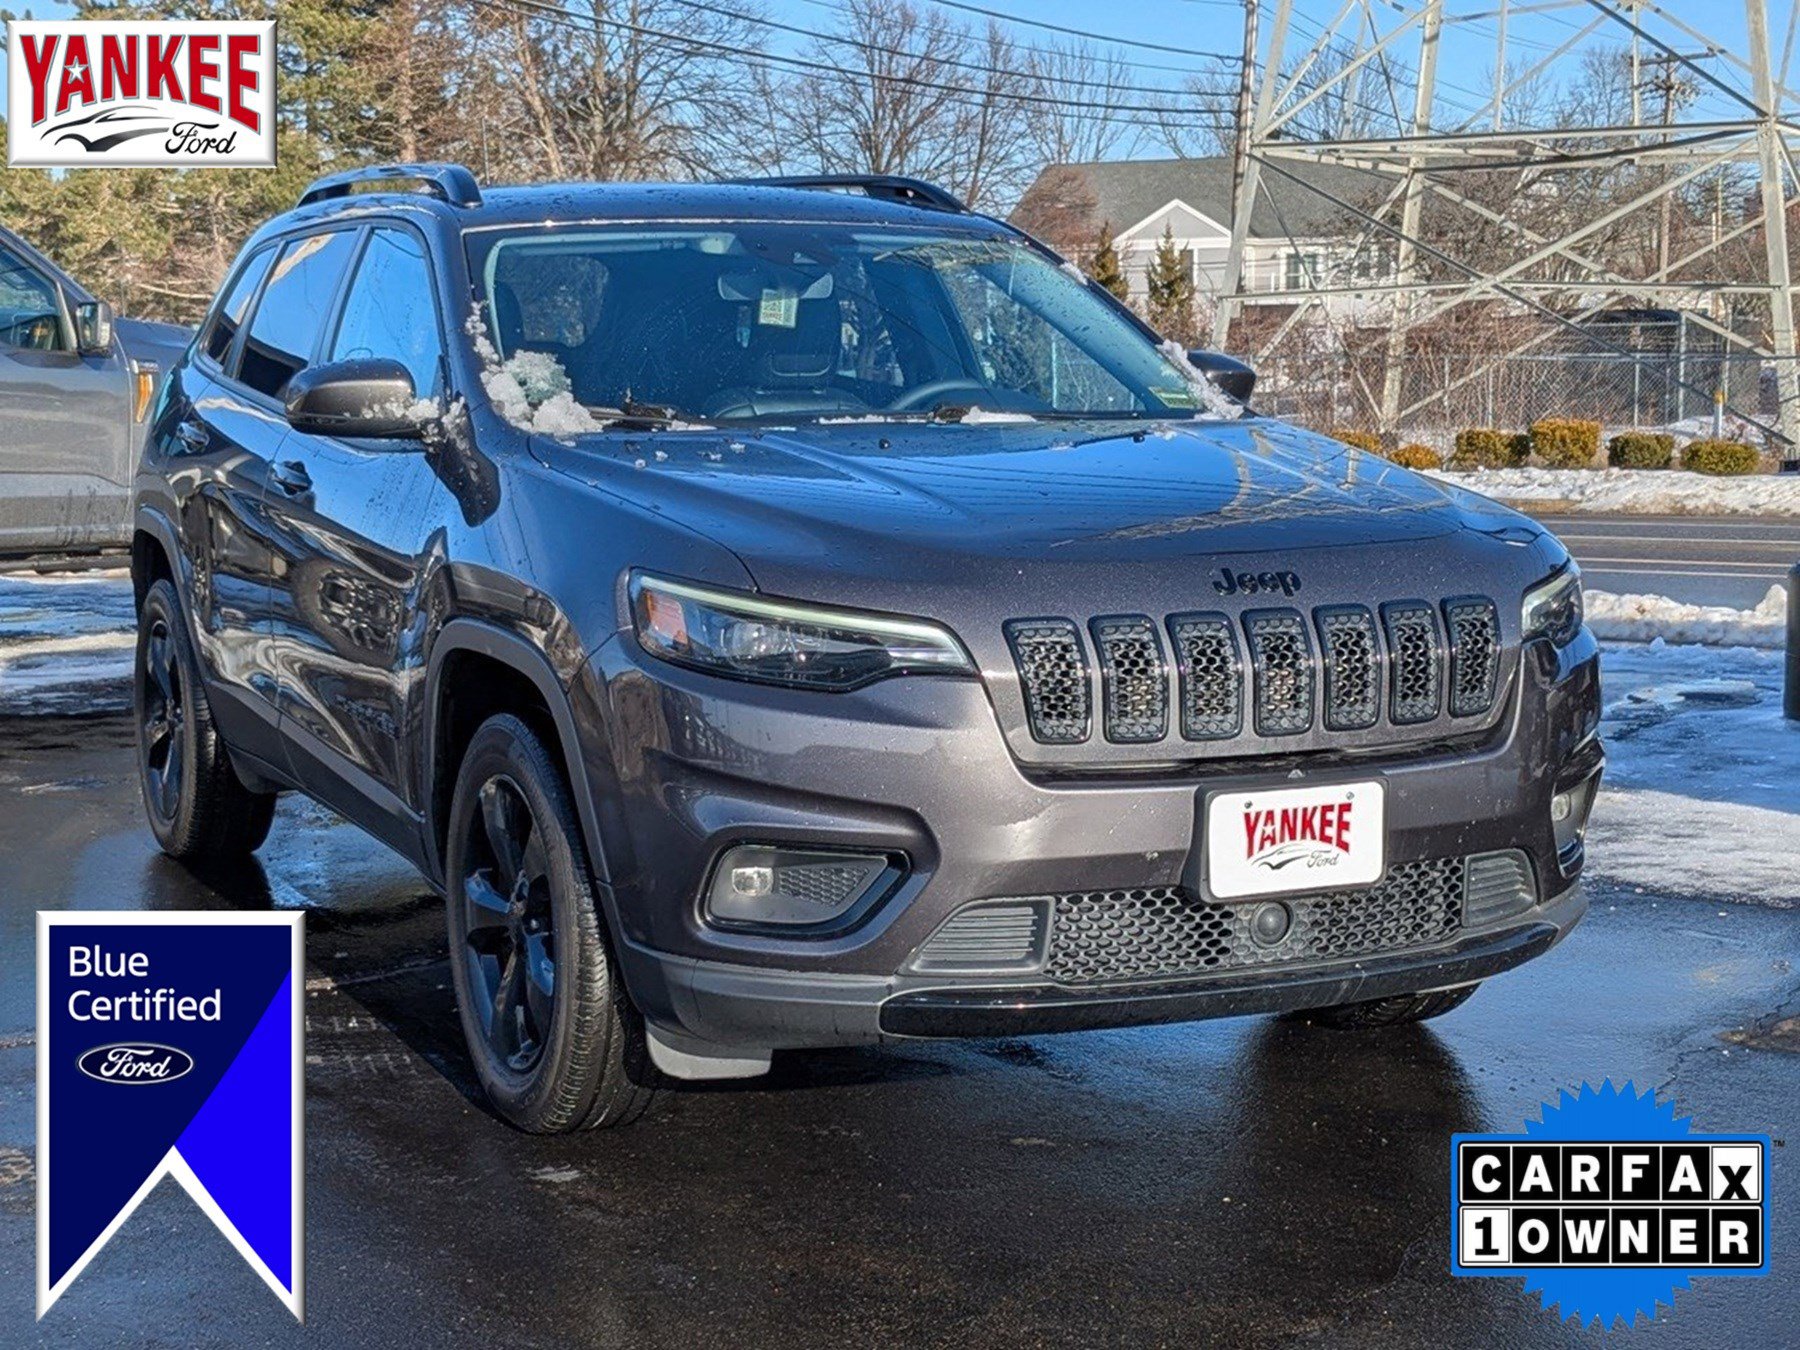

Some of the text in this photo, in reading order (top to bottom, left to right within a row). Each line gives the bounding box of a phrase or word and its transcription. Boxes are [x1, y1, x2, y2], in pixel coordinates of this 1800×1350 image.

[1212, 567, 1301, 597] Jeep
[1243, 801, 1353, 861] YANKEE
[1306, 851, 1339, 868] Ford
